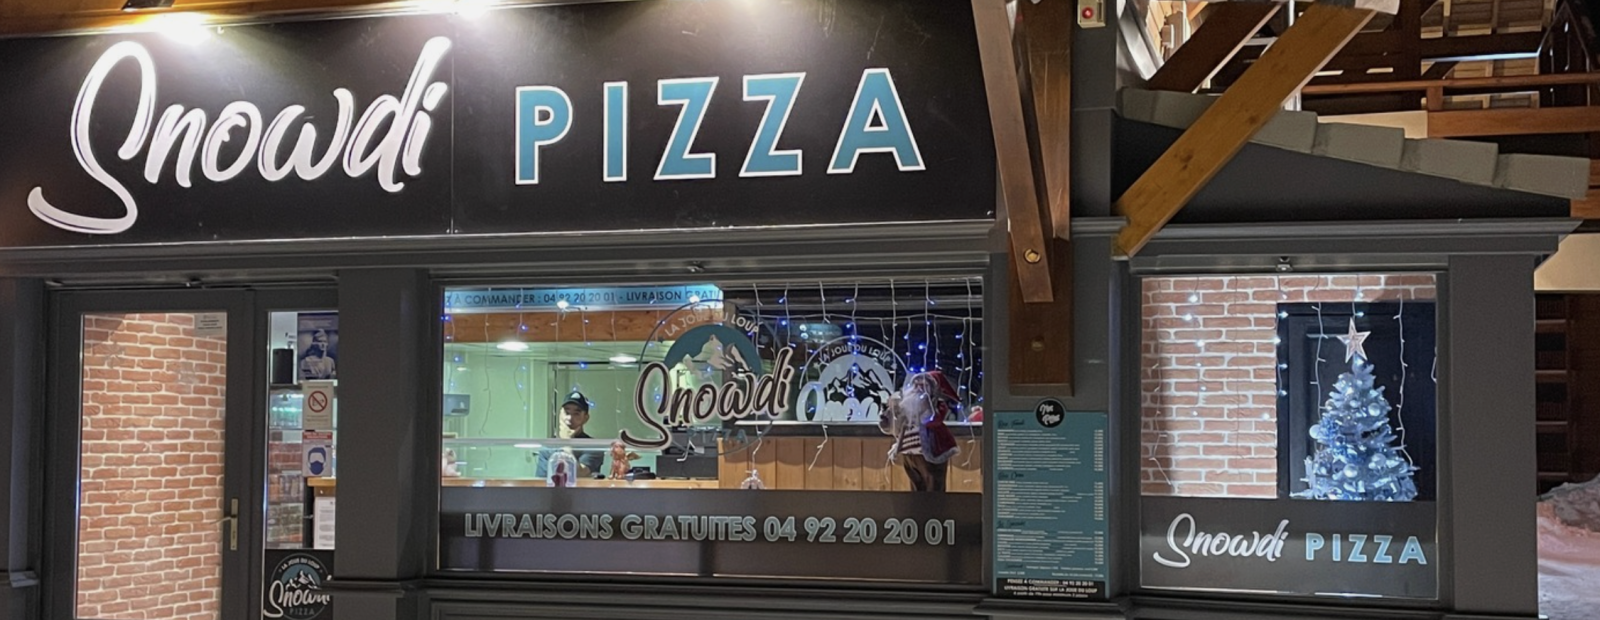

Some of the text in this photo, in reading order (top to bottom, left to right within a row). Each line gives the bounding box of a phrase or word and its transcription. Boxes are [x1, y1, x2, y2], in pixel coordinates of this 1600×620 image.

[28, 36, 927, 234] Snowdi PIZZA
[464, 293, 535, 305] COMMANDER
[543, 293, 556, 303] 04
[588, 292, 601, 302] 20
[603, 292, 615, 302] 01
[626, 290, 682, 301] LIVRAISON
[664, 324, 680, 337] LA
[731, 315, 760, 334] LOUP
[831, 344, 853, 357] JOUE
[619, 347, 795, 451] Snowdi
[464, 513, 955, 546] LIVRAISONS GRATUITES 04 92 20 20 01
[1153, 513, 1290, 568] Snowdi
[1305, 532, 1428, 566] PIZZA
